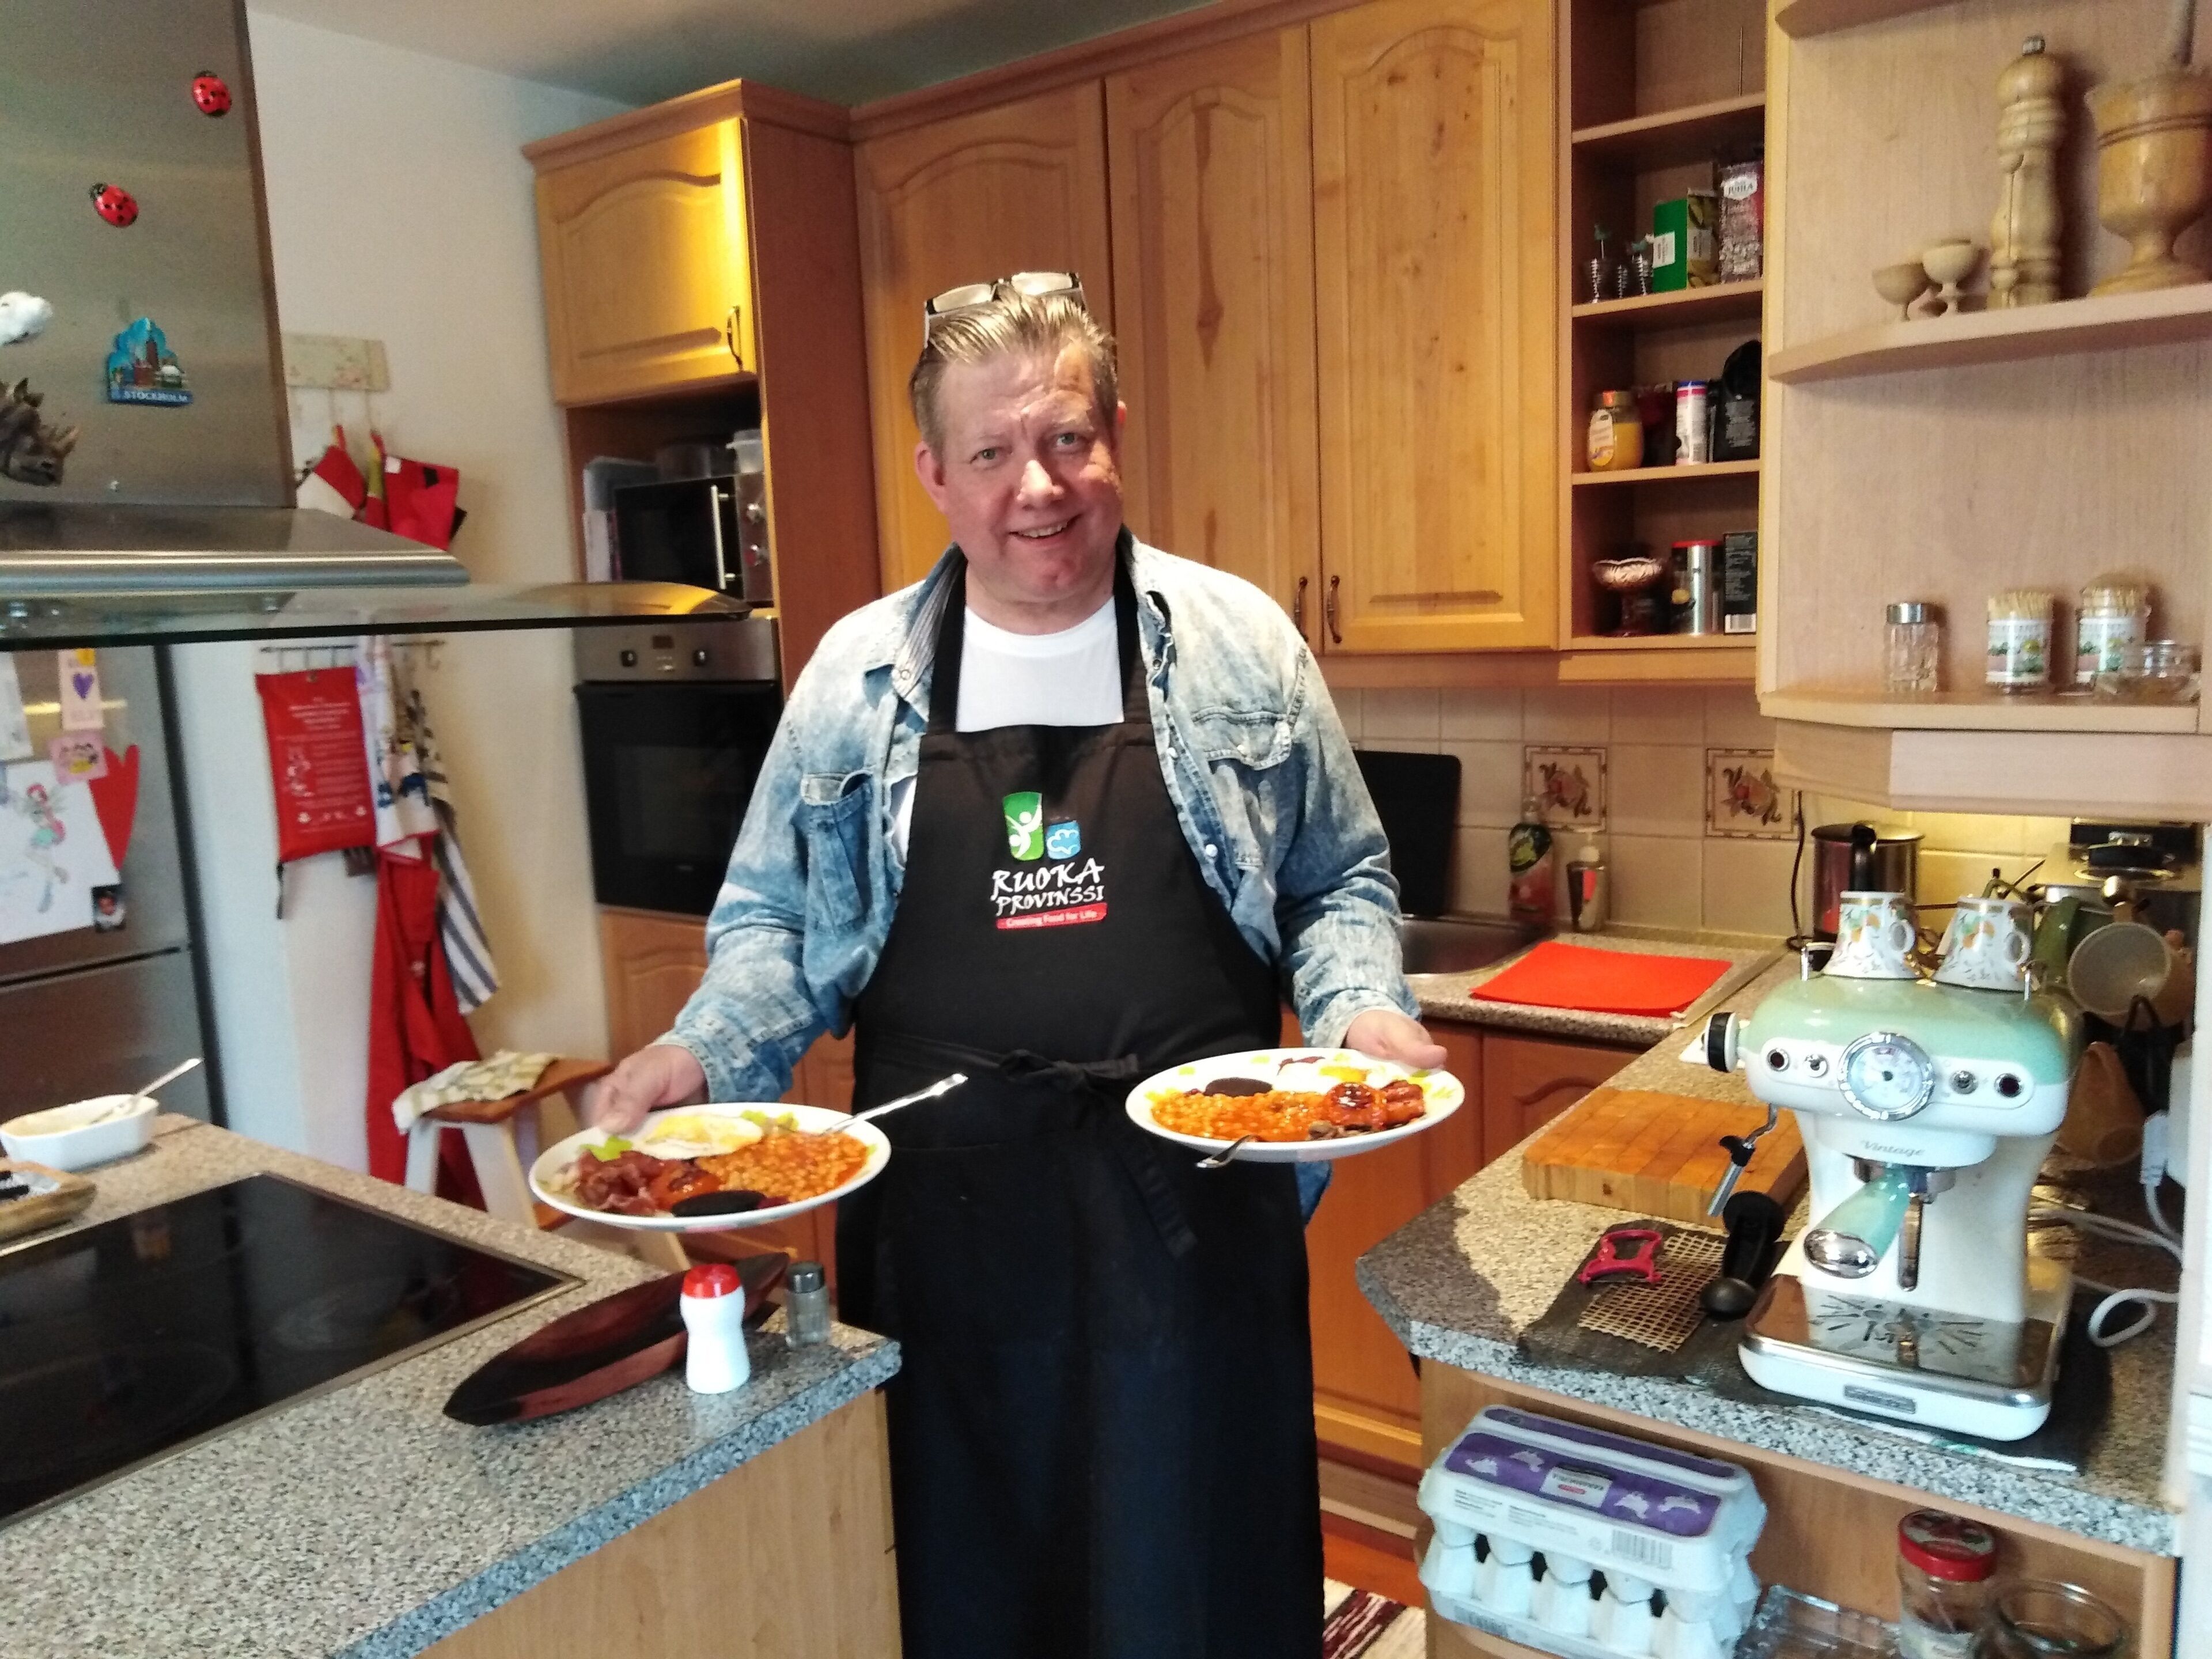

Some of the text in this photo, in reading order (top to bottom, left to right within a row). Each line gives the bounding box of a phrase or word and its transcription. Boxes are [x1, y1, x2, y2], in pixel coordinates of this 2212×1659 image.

[123, 391, 188, 402] STOCKHOLM
[990, 858, 1105, 901] RUOKA
[996, 885, 1105, 916] PROVINSSI
[1861, 1140, 1925, 1157] Vintage
